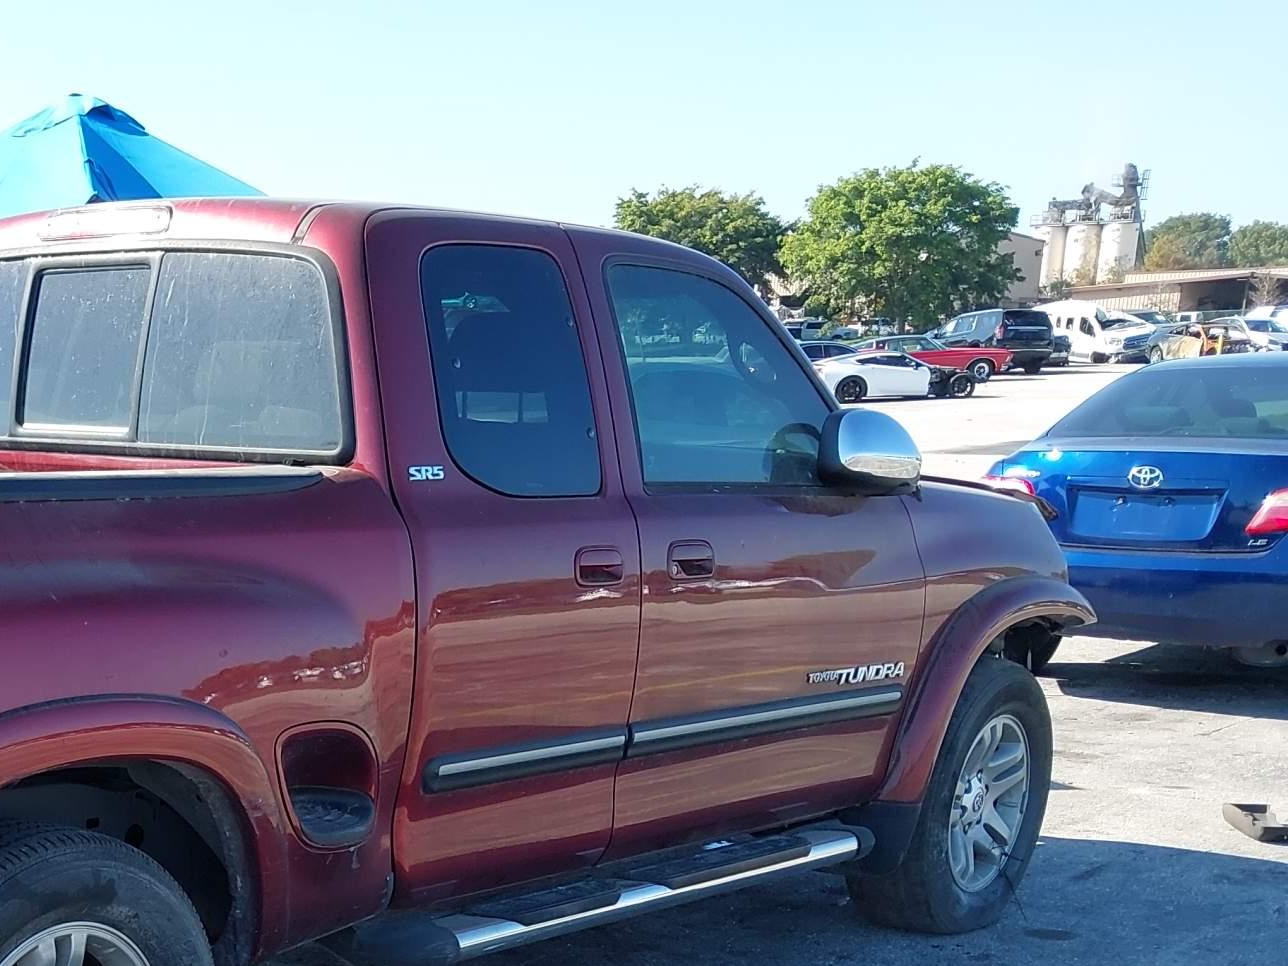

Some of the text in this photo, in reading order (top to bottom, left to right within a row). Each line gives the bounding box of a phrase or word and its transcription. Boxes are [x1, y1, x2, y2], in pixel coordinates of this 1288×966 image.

[408, 465, 444, 481] SR5
[1247, 538, 1268, 546] LE
[807, 661, 905, 685] TOYOTA TUNDRA
